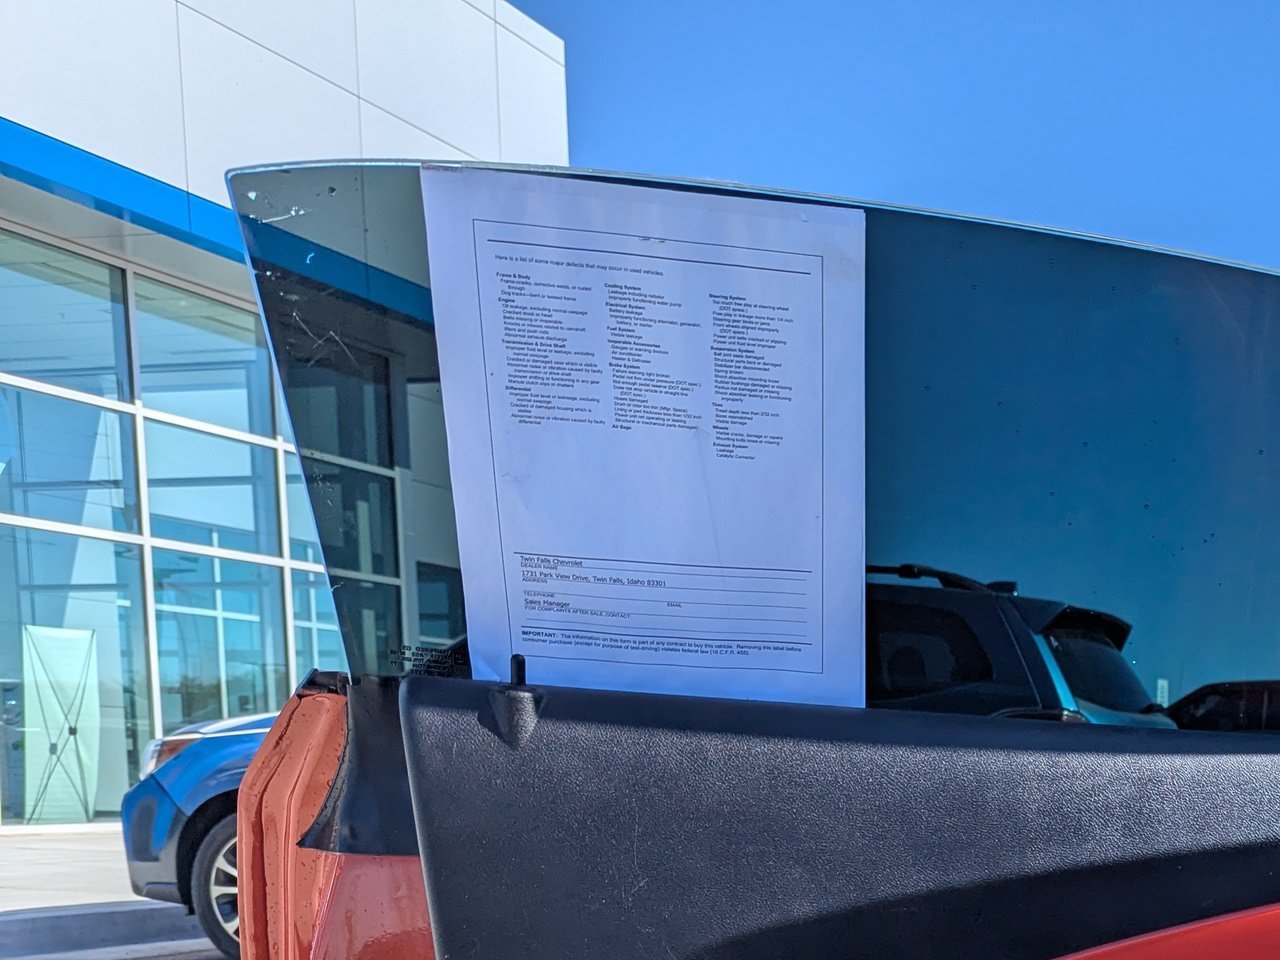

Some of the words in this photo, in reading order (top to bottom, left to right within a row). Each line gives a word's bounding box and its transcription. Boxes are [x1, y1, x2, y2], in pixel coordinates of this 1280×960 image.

[496, 271, 512, 279] Frame
[604, 282, 624, 291] Cooling
[623, 284, 642, 293] System
[498, 296, 516, 305] Engine
[708, 292, 729, 301] Steering
[729, 294, 747, 303] System
[628, 303, 646, 312] System
[618, 326, 636, 335] System
[623, 363, 641, 371] System
[552, 559, 584, 567] Chevrolet
[572, 575, 591, 583] Drive,
[609, 577, 625, 585] Falls,
[646, 579, 667, 587] 83301
[542, 600, 571, 609] Manager
